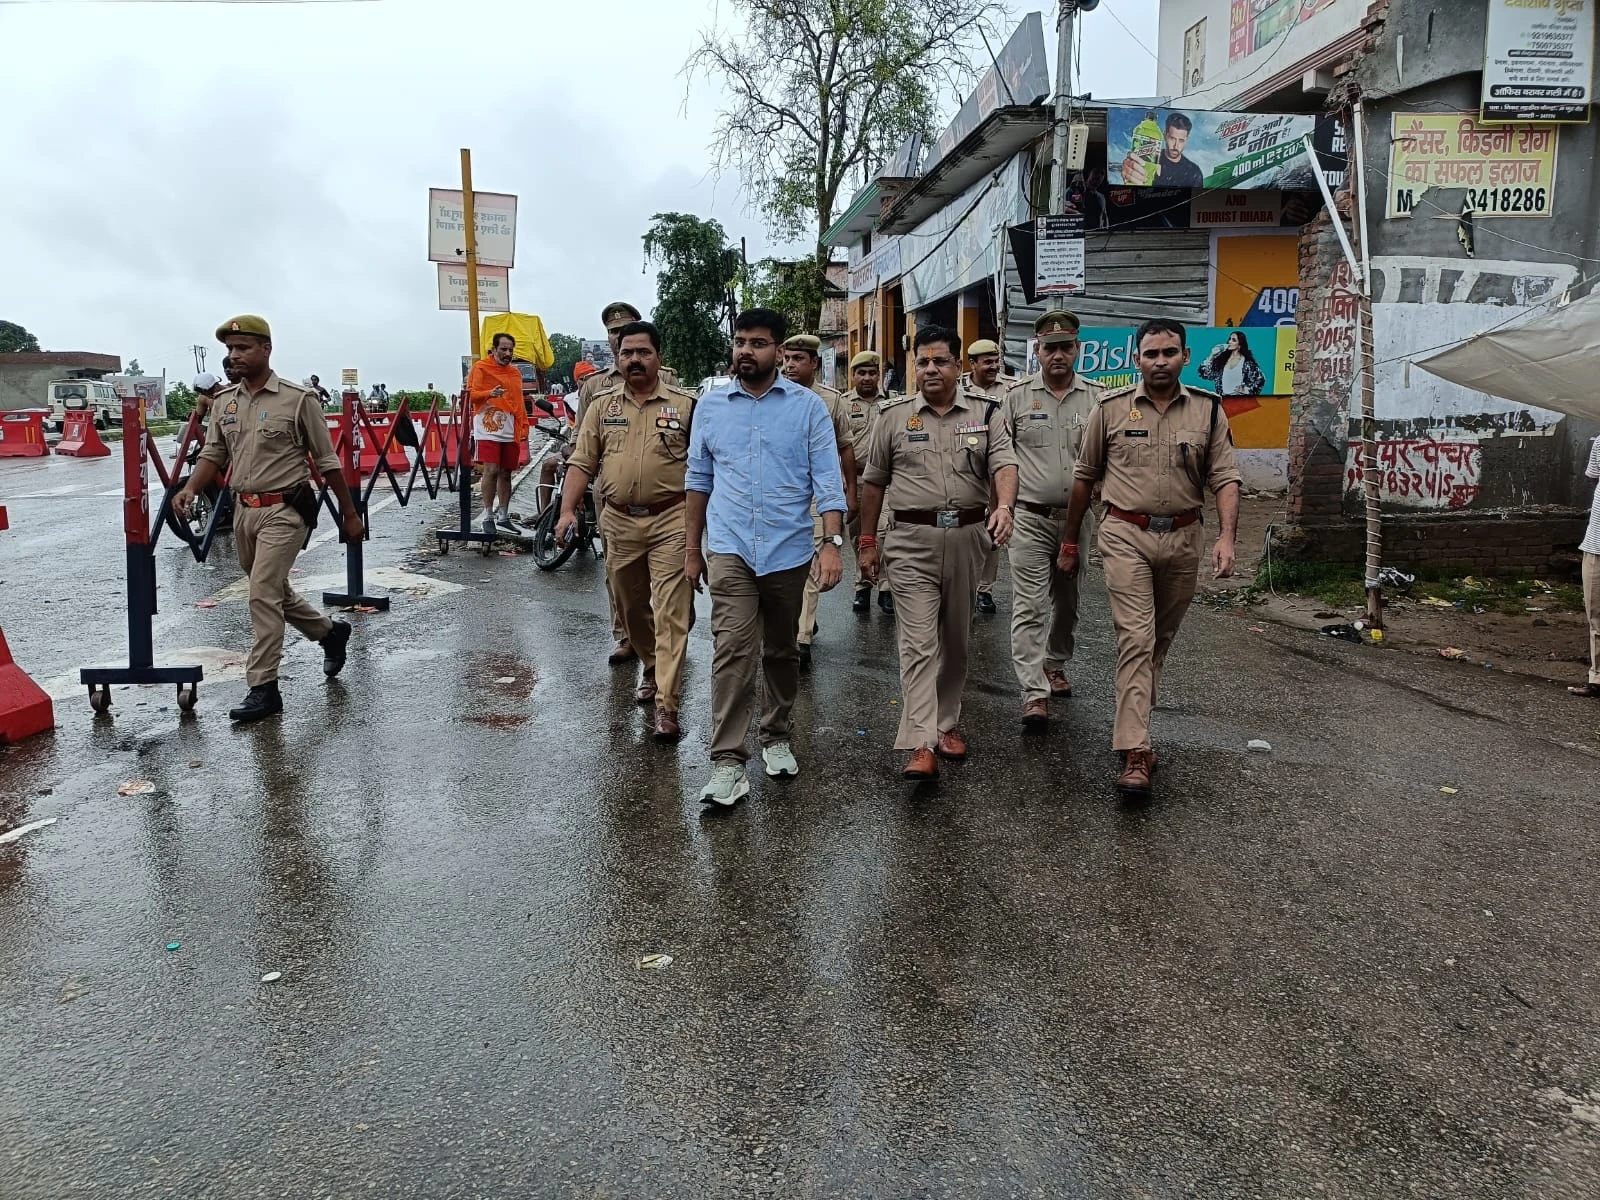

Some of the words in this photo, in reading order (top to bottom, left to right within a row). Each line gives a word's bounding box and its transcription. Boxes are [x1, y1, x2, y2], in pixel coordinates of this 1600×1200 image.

[1457, 118, 1515, 156] किडनी
[1518, 122, 1552, 154] रोग
[1405, 160, 1431, 184] का
[1434, 160, 1487, 185] सफल
[1488, 160, 1542, 188] इलाज
[1197, 210, 1237, 224] TOURIST
[1258, 288, 1299, 314] 400
[1077, 333, 1139, 375] Bisl
